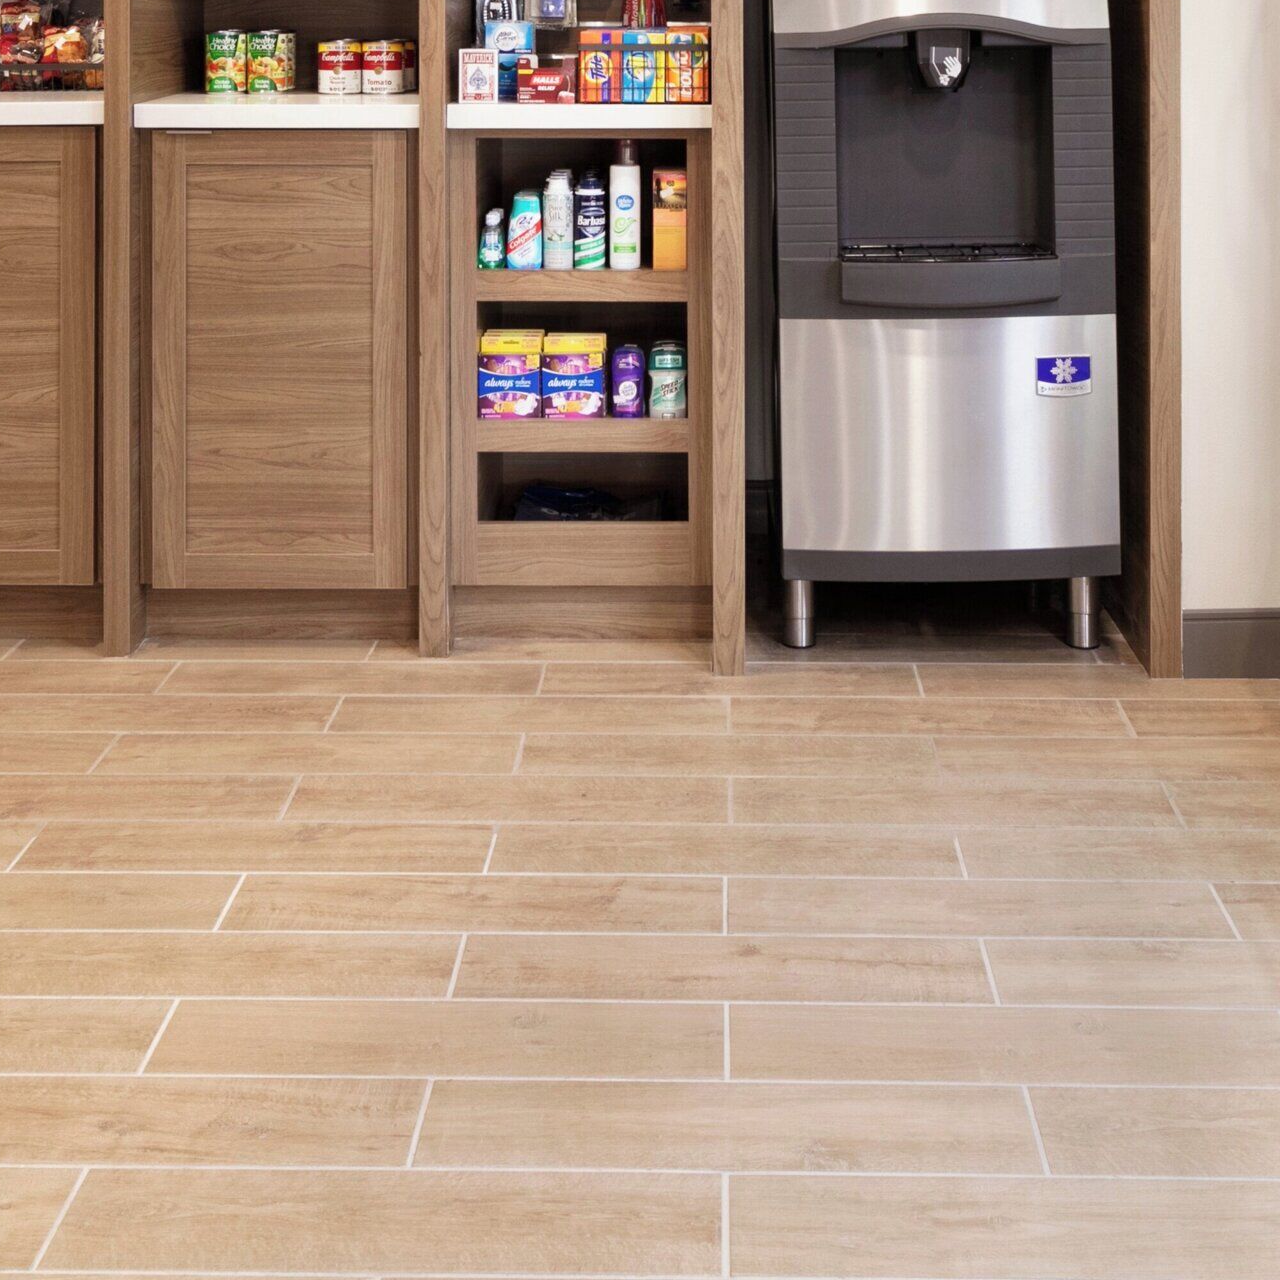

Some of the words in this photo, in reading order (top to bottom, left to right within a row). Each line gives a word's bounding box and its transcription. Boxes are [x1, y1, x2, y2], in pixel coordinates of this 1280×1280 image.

[210, 42, 237, 51] Choice
[251, 42, 275, 51] Choice
[590, 54, 604, 79] Tide
[533, 75, 563, 85] HALLS
[508, 227, 538, 250] Colgate
[484, 377, 514, 388] always
[548, 377, 577, 388] always
